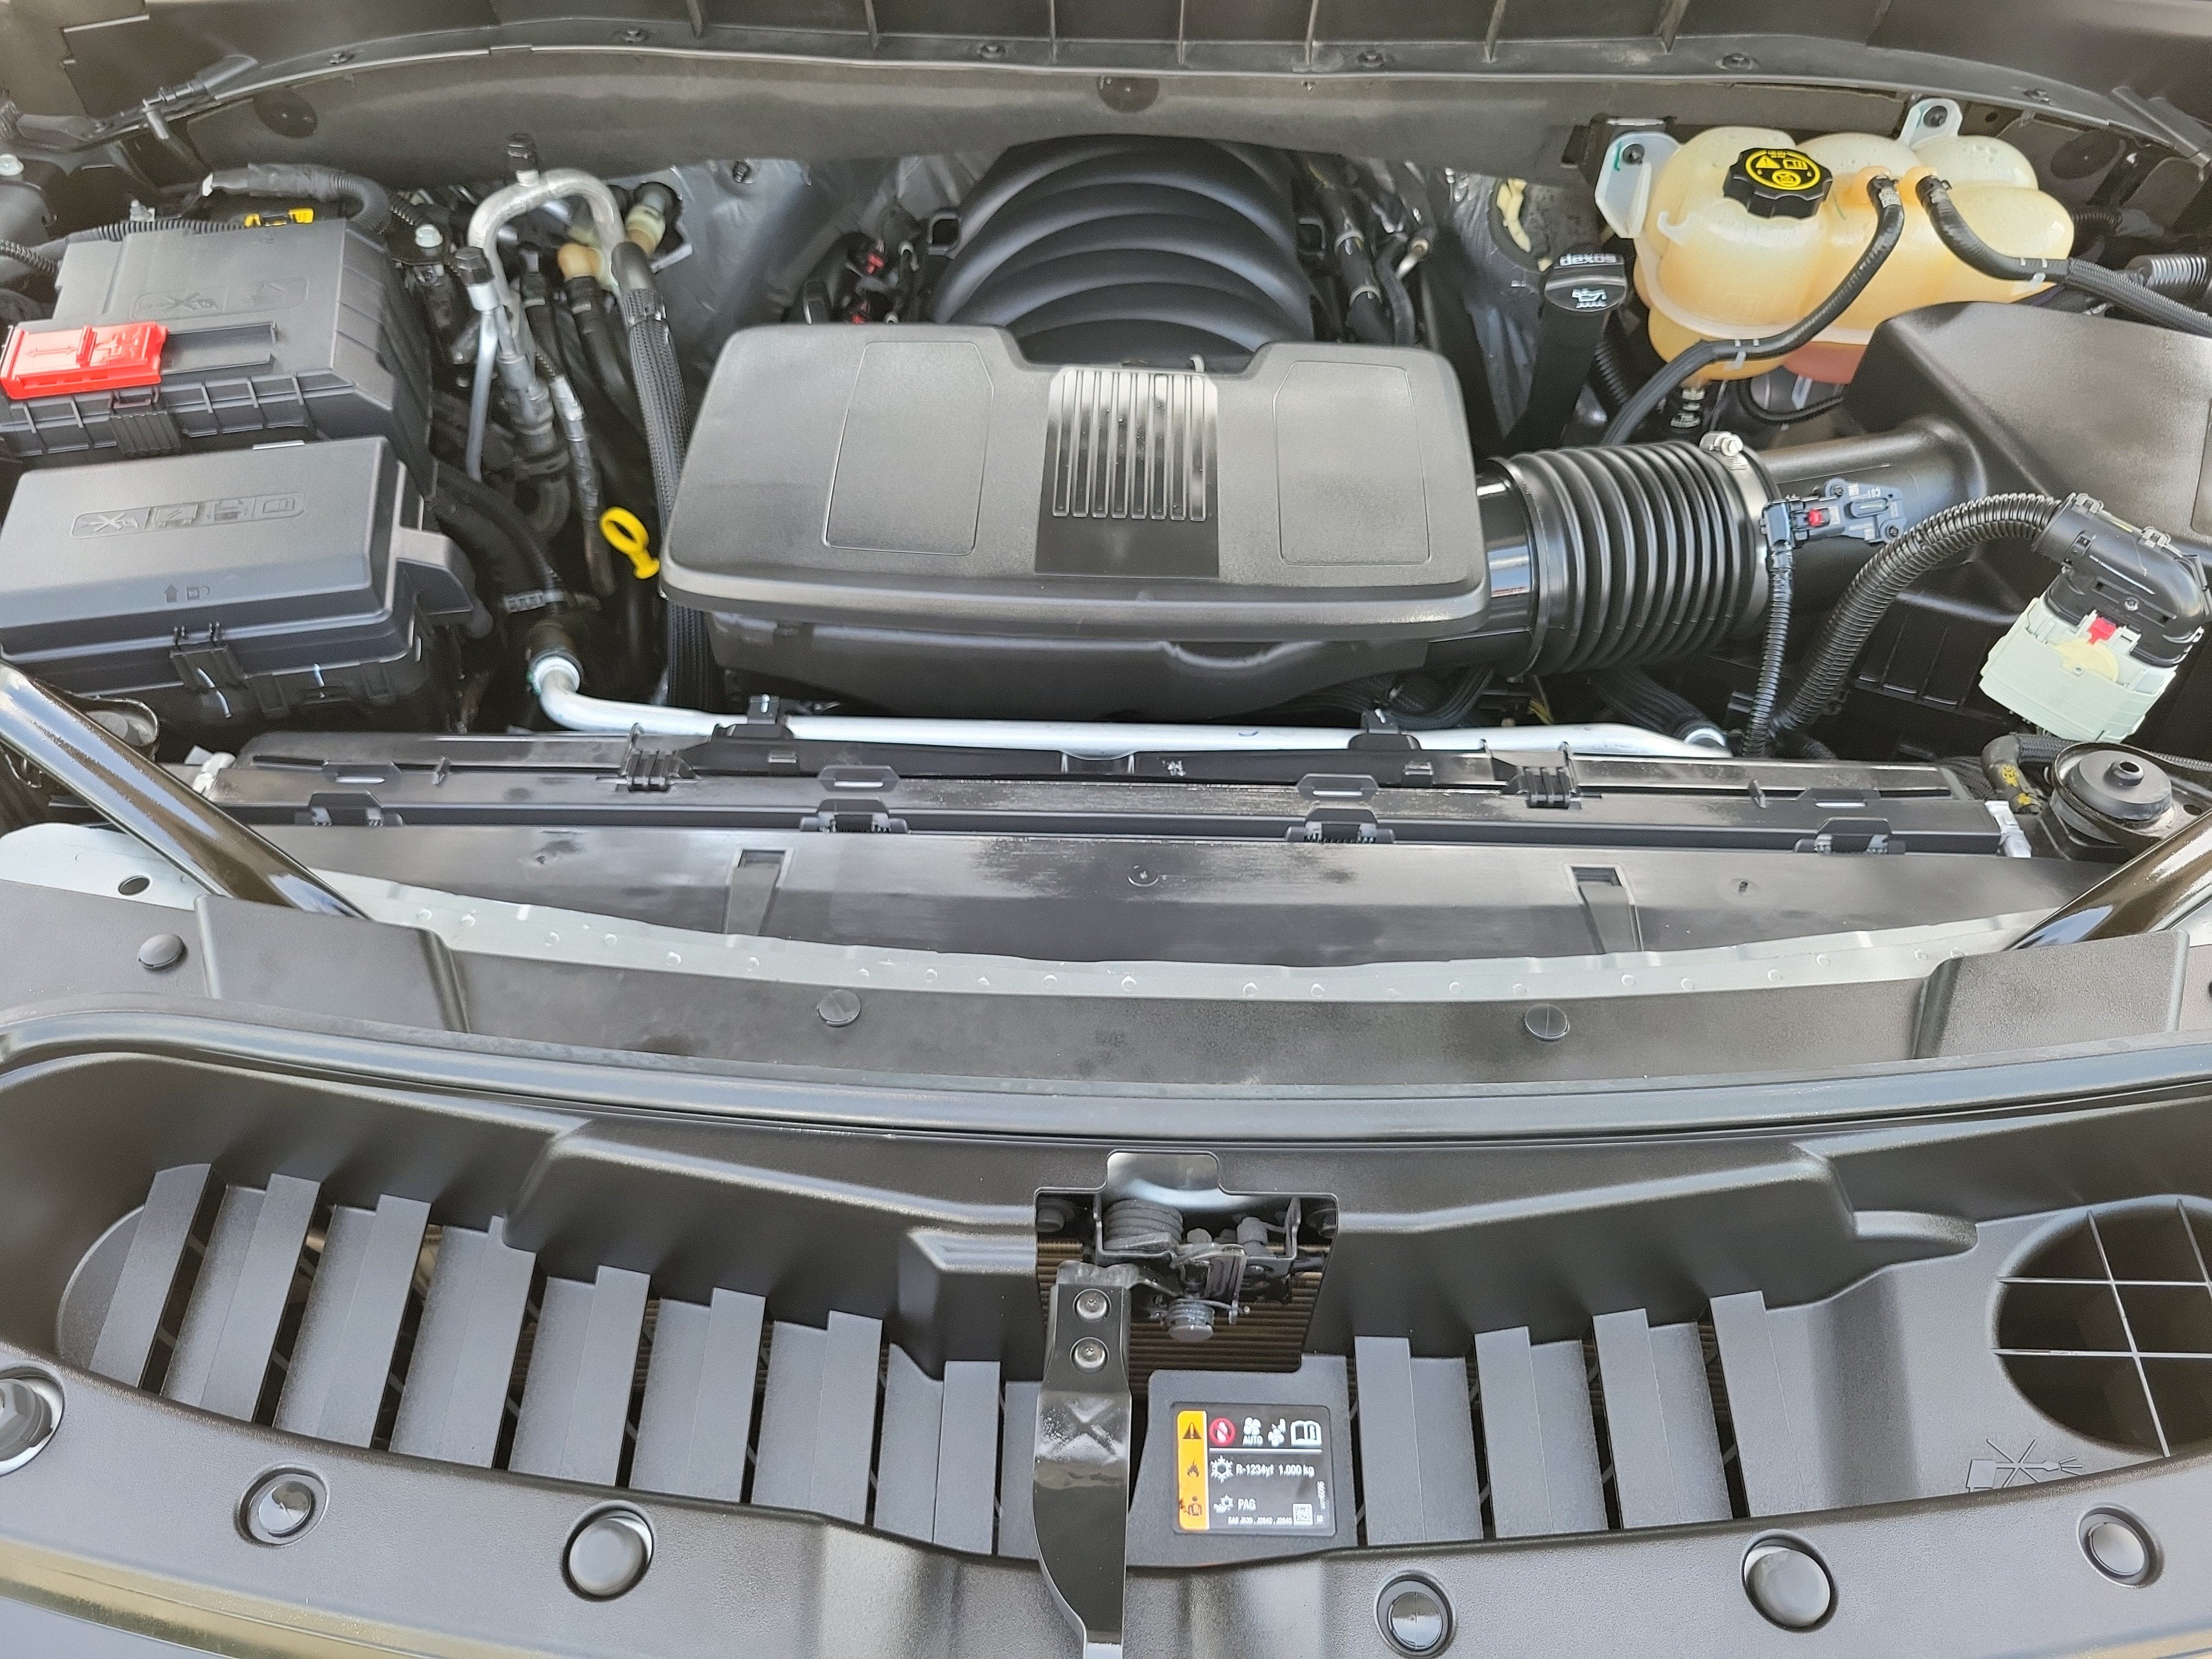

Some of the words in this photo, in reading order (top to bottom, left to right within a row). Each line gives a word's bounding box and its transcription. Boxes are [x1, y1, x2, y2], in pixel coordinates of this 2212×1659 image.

[1560, 253, 1617, 266] dexos
[1243, 1435, 1263, 1446] AUTO
[1235, 1464, 1274, 1477] R-1234yf
[1278, 1464, 1302, 1476] 1.000
[1303, 1464, 1315, 1478] kg
[1238, 1498, 1256, 1510] PAG
